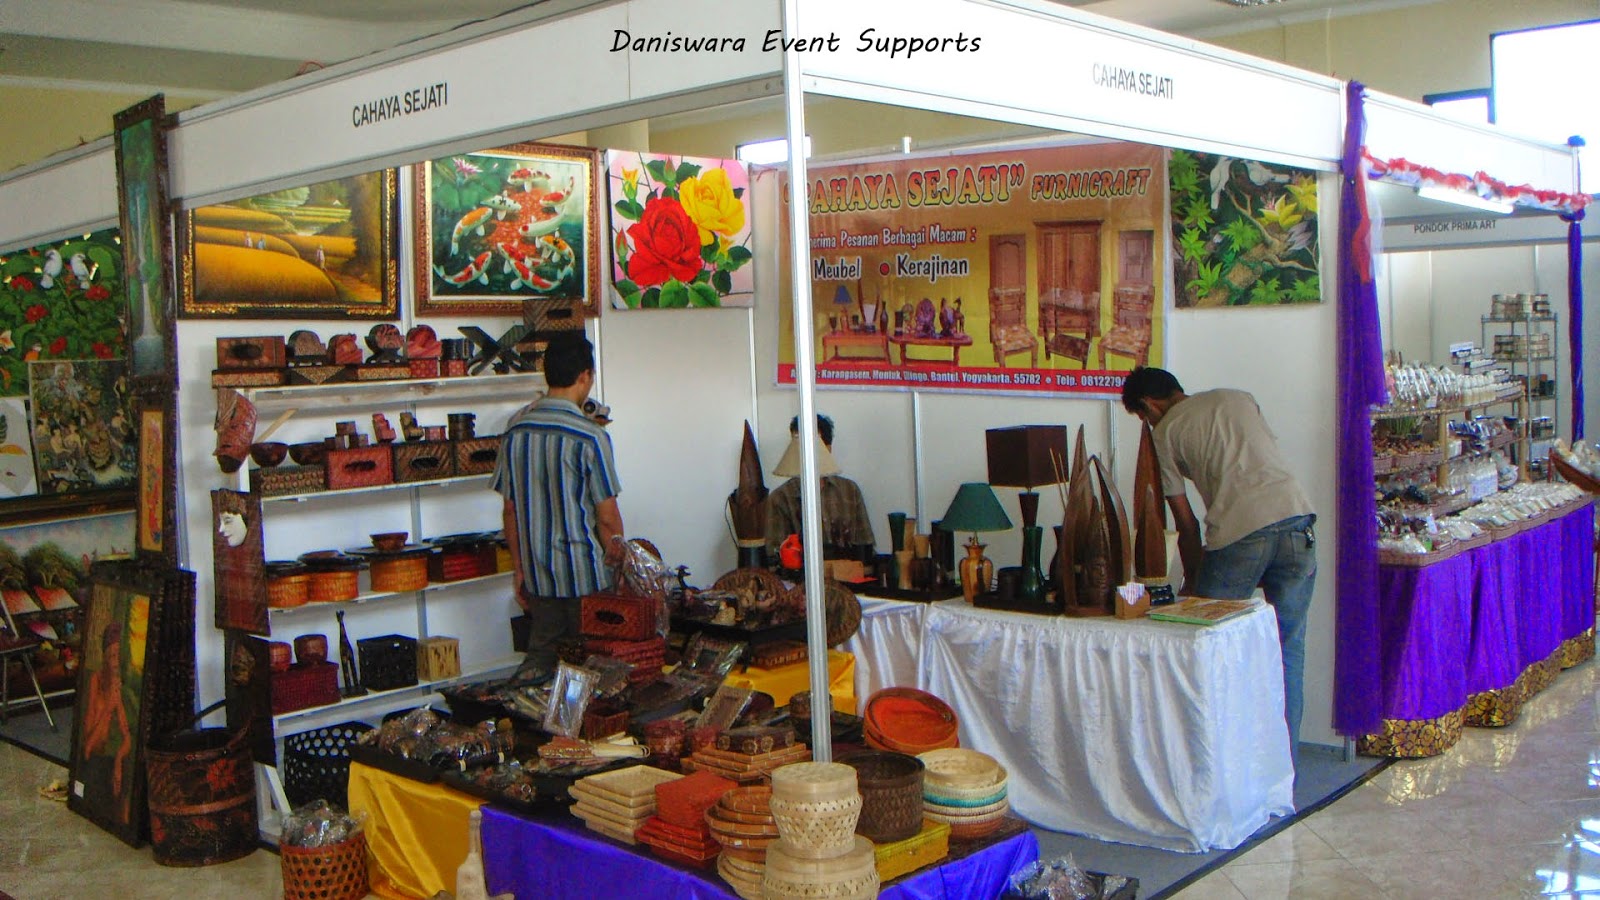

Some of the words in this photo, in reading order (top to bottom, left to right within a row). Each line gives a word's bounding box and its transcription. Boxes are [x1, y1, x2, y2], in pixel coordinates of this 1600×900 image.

[1092, 62, 1137, 93] CAHAYA
[1138, 72, 1174, 100] SEJATI
[353, 95, 401, 127] CAHAYA
[404, 82, 448, 115] SEJATI
[784, 174, 901, 213] AHAYA
[1031, 168, 1152, 200] FURNICRAFT
[840, 230, 879, 248] Pesanan
[883, 226, 926, 250] Berbagai
[929, 224, 966, 243] Macam
[1414, 222, 1449, 234] PONDOK
[1452, 220, 1478, 231] PRIMA
[1480, 219, 1496, 229] ART
[813, 257, 861, 279] Meubel
[897, 254, 968, 283] Kerajinan
